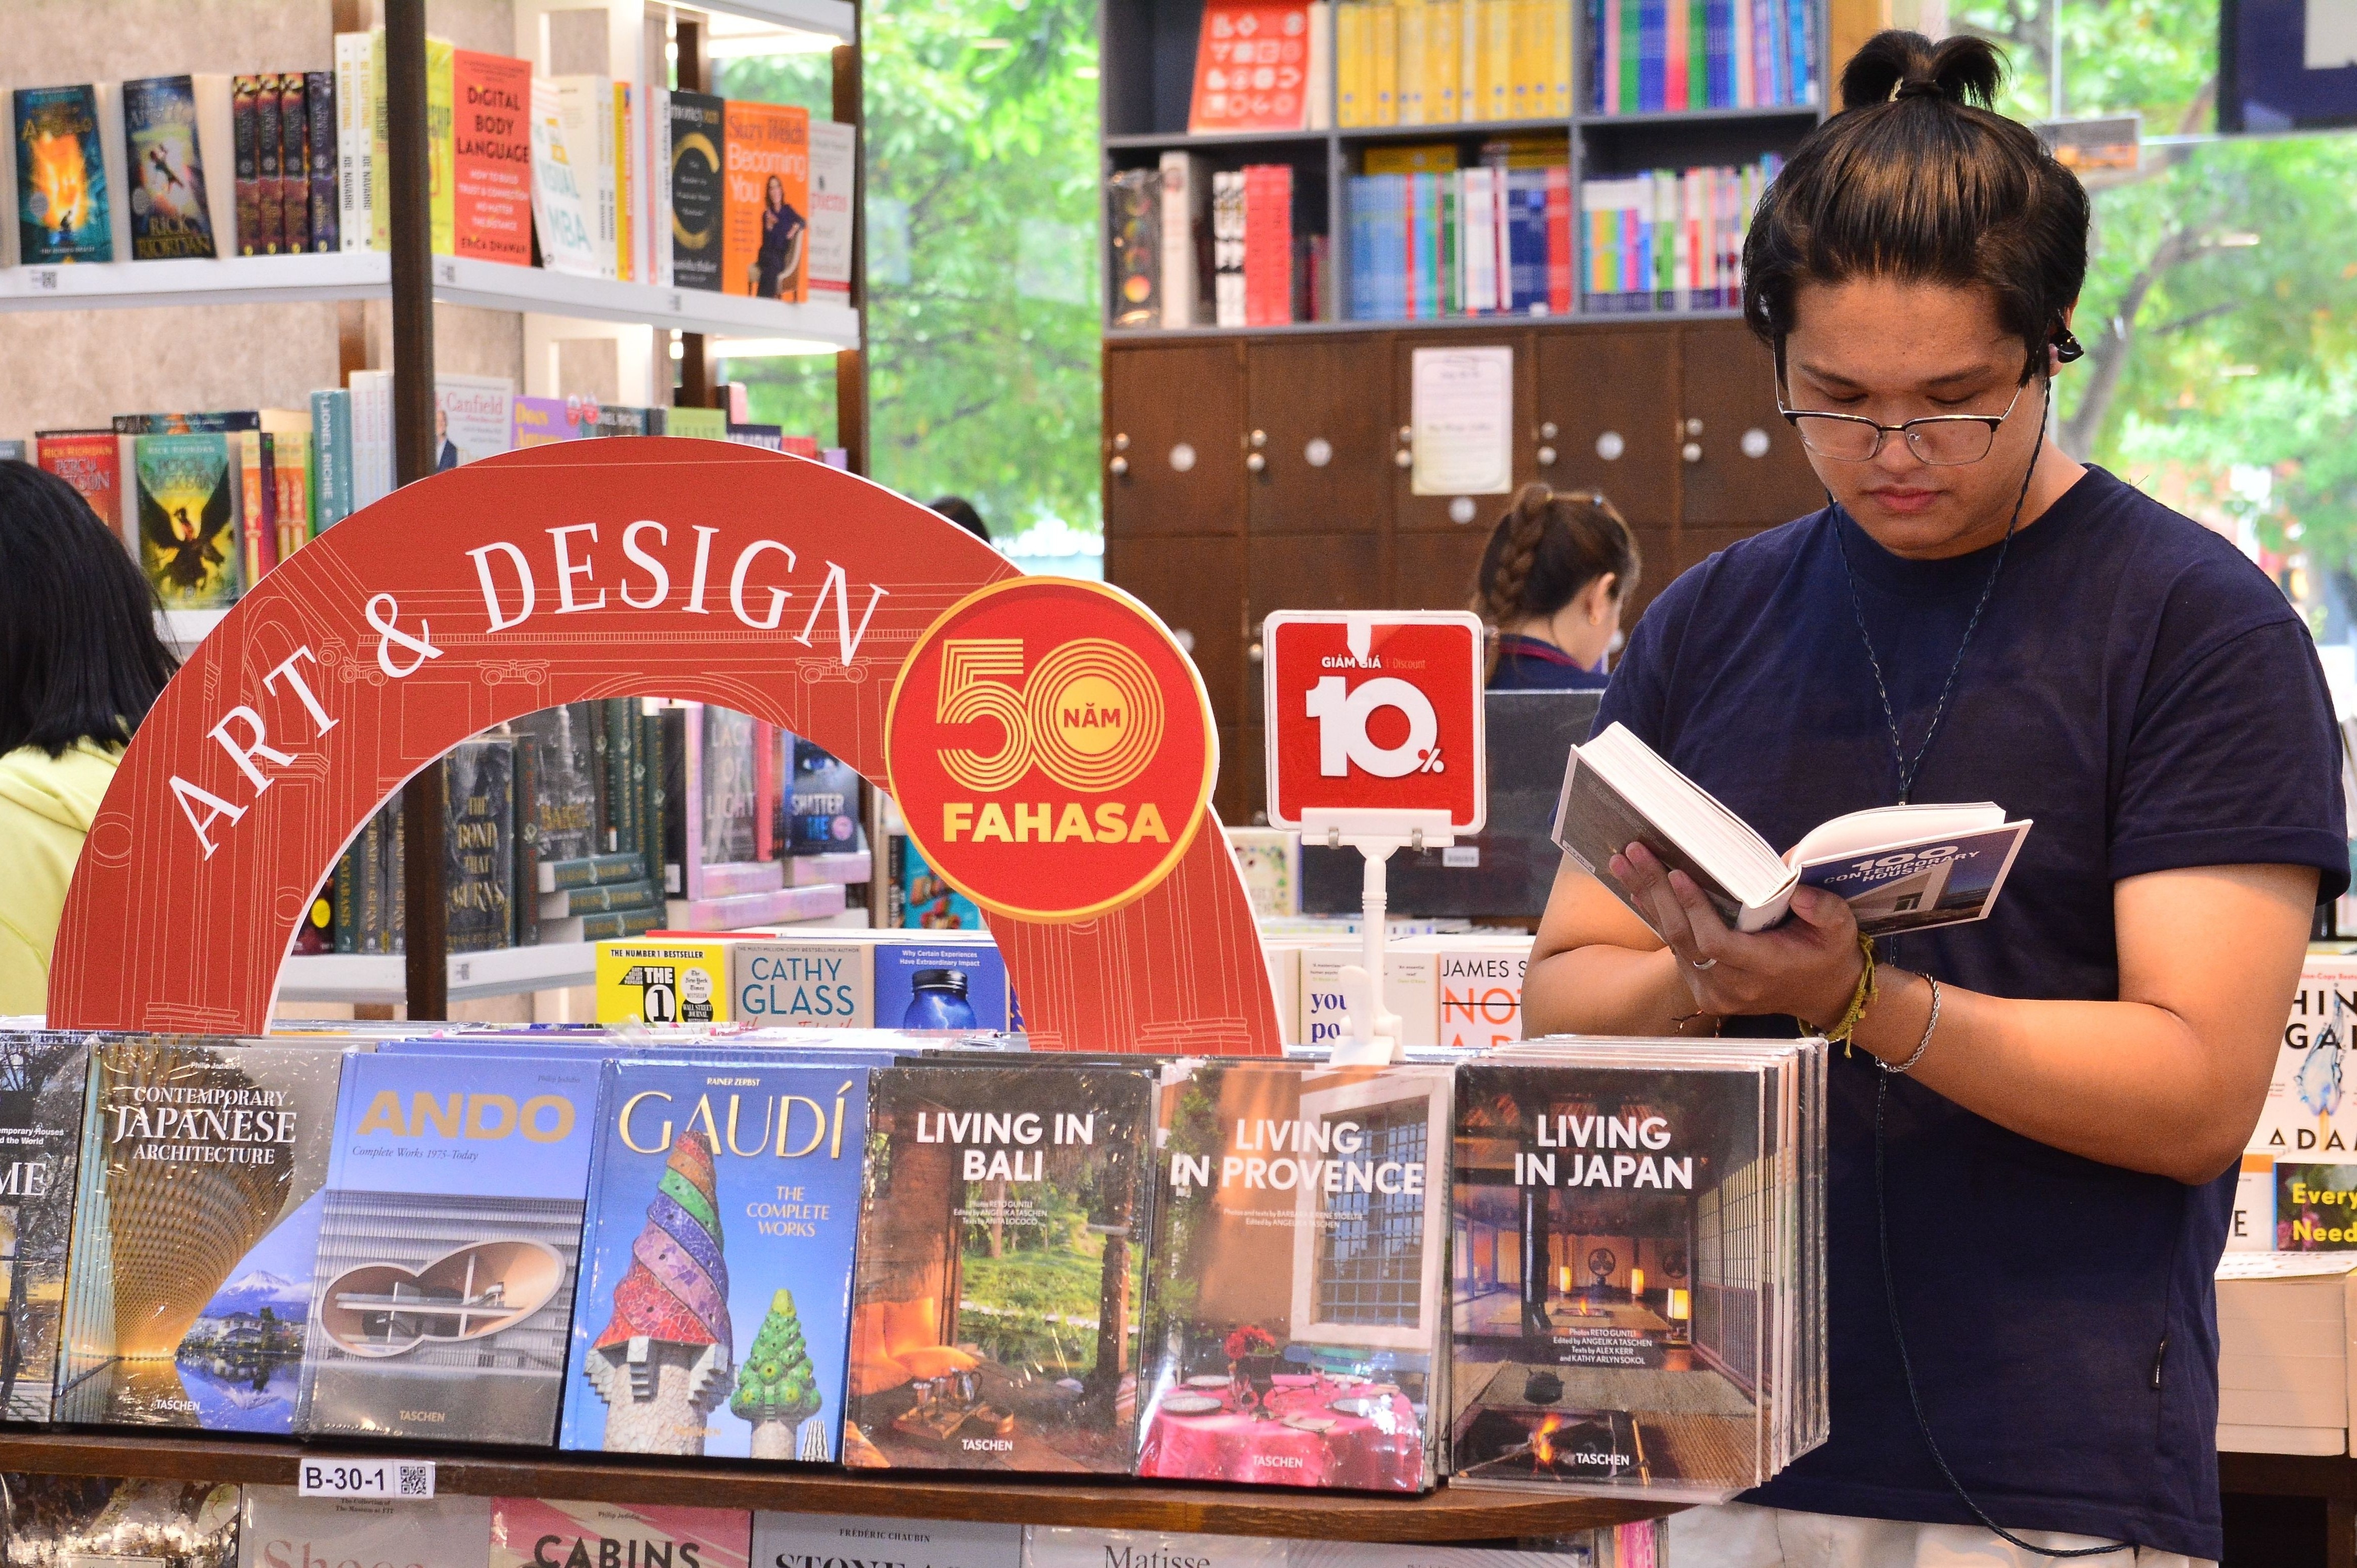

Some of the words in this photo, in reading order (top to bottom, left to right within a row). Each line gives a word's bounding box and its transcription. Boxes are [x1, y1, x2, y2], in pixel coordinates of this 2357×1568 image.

[475, 114, 514, 137] BODY
[457, 137, 529, 163] LANGUAGE
[728, 143, 806, 183] Becoming
[345, 172, 354, 210] NAVARRO
[363, 172, 372, 210] NAVARRO
[730, 175, 761, 203] You
[546, 205, 593, 253] MBA
[321, 399, 331, 451] LIONEL
[322, 454, 333, 500] RICHIE
[1321, 654, 1356, 668] GIẢM
[1359, 655, 1382, 669] GIÁ
[1393, 659, 1426, 670] Discount
[168, 644, 339, 861] ART
[365, 593, 445, 678] &
[464, 519, 890, 668] DESIGN
[935, 637, 1165, 793] 50
[1063, 702, 1121, 728] NĂM
[706, 792, 754, 819] LIGHT
[792, 794, 844, 816] SHATTER
[943, 802, 1171, 844] FAHASA
[456, 821, 498, 850] BOND
[464, 855, 490, 874] THAT
[1823, 851, 1981, 884] CONTEMPORARY
[1852, 845, 1959, 872] 100
[1862, 864, 1936, 883] HOUSES
[610, 949, 623, 957] THE
[625, 949, 656, 958] NUMBER
[664, 950, 704, 959] BESTSELLER
[916, 959, 957, 967] Extraordinary
[941, 951, 978, 960] Experiences
[643, 967, 674, 984] THE
[751, 956, 843, 982] CATHY
[1442, 959, 1509, 978] JAMES
[652, 989, 670, 1022] 1
[741, 983, 855, 1016] GLASS
[1445, 986, 1522, 1025] NO
[191, 1062, 210, 1070] Philip
[707, 1077, 733, 1086] RAINER
[733, 1077, 761, 1087] ZERBST
[134, 1086, 287, 1107] CONTEMPORARY
[112, 1105, 297, 1144] JAPANESE
[356, 1090, 576, 1144] ANDO
[618, 1079, 853, 1160] GAUDÍ
[916, 1112, 1043, 1145] LIVING
[1054, 1113, 1094, 1146] IN
[21, 1137, 44, 1145] World
[35, 1127, 64, 1136] Houses
[1235, 1118, 1363, 1154] LIVING
[1537, 1114, 1671, 1150] LIVING
[2268, 1127, 2357, 1152] ADA
[133, 1144, 276, 1165] ARCHITECTURE
[352, 1146, 394, 1159] Complete
[397, 1147, 424, 1158] Works
[962, 1149, 1044, 1182] BALI
[1169, 1153, 1210, 1187] IN
[1221, 1156, 1424, 1195] PROVENCE
[1514, 1153, 1556, 1186] IN
[1567, 1154, 1693, 1190] JAPAN
[0, 1161, 47, 1196] ME
[775, 1185, 804, 1202] THE
[746, 1203, 830, 1221] COMPLETE
[953, 1208, 972, 1216] Edited
[757, 1220, 816, 1238] WORKS
[1553, 1336, 1573, 1344] Edited
[1574, 1337, 1581, 1345] by
[1581, 1337, 1619, 1345] ANGELIKA
[1619, 1339, 1652, 1347] TASCHEN
[1568, 1328, 1590, 1336] Photos
[1590, 1329, 1609, 1337] RETO
[1609, 1329, 1637, 1338] GUNTLI
[1572, 1345, 1587, 1354] Texts
[1588, 1346, 1595, 1355] by
[1595, 1346, 1614, 1355] ALEX
[1614, 1347, 1634, 1355] KERR
[1596, 1356, 1620, 1364] ARLYN
[1620, 1357, 1645, 1365] SOKOL
[155, 1399, 201, 1413] TASCHEN
[399, 1409, 446, 1423] TASCHEN
[962, 1438, 1013, 1452] TASCHEN
[1252, 1454, 1304, 1468] TASCHEN
[1575, 1452, 1630, 1467] TASCHEN
[305, 1466, 385, 1491] B-30-1
[597, 1510, 617, 1519] Philip
[839, 1527, 886, 1539] FRÉDÉRIC
[888, 1533, 931, 1542] CHAUBIN
[534, 1535, 701, 1568] CABINS
[1104, 1545, 1211, 1568] Matisse
